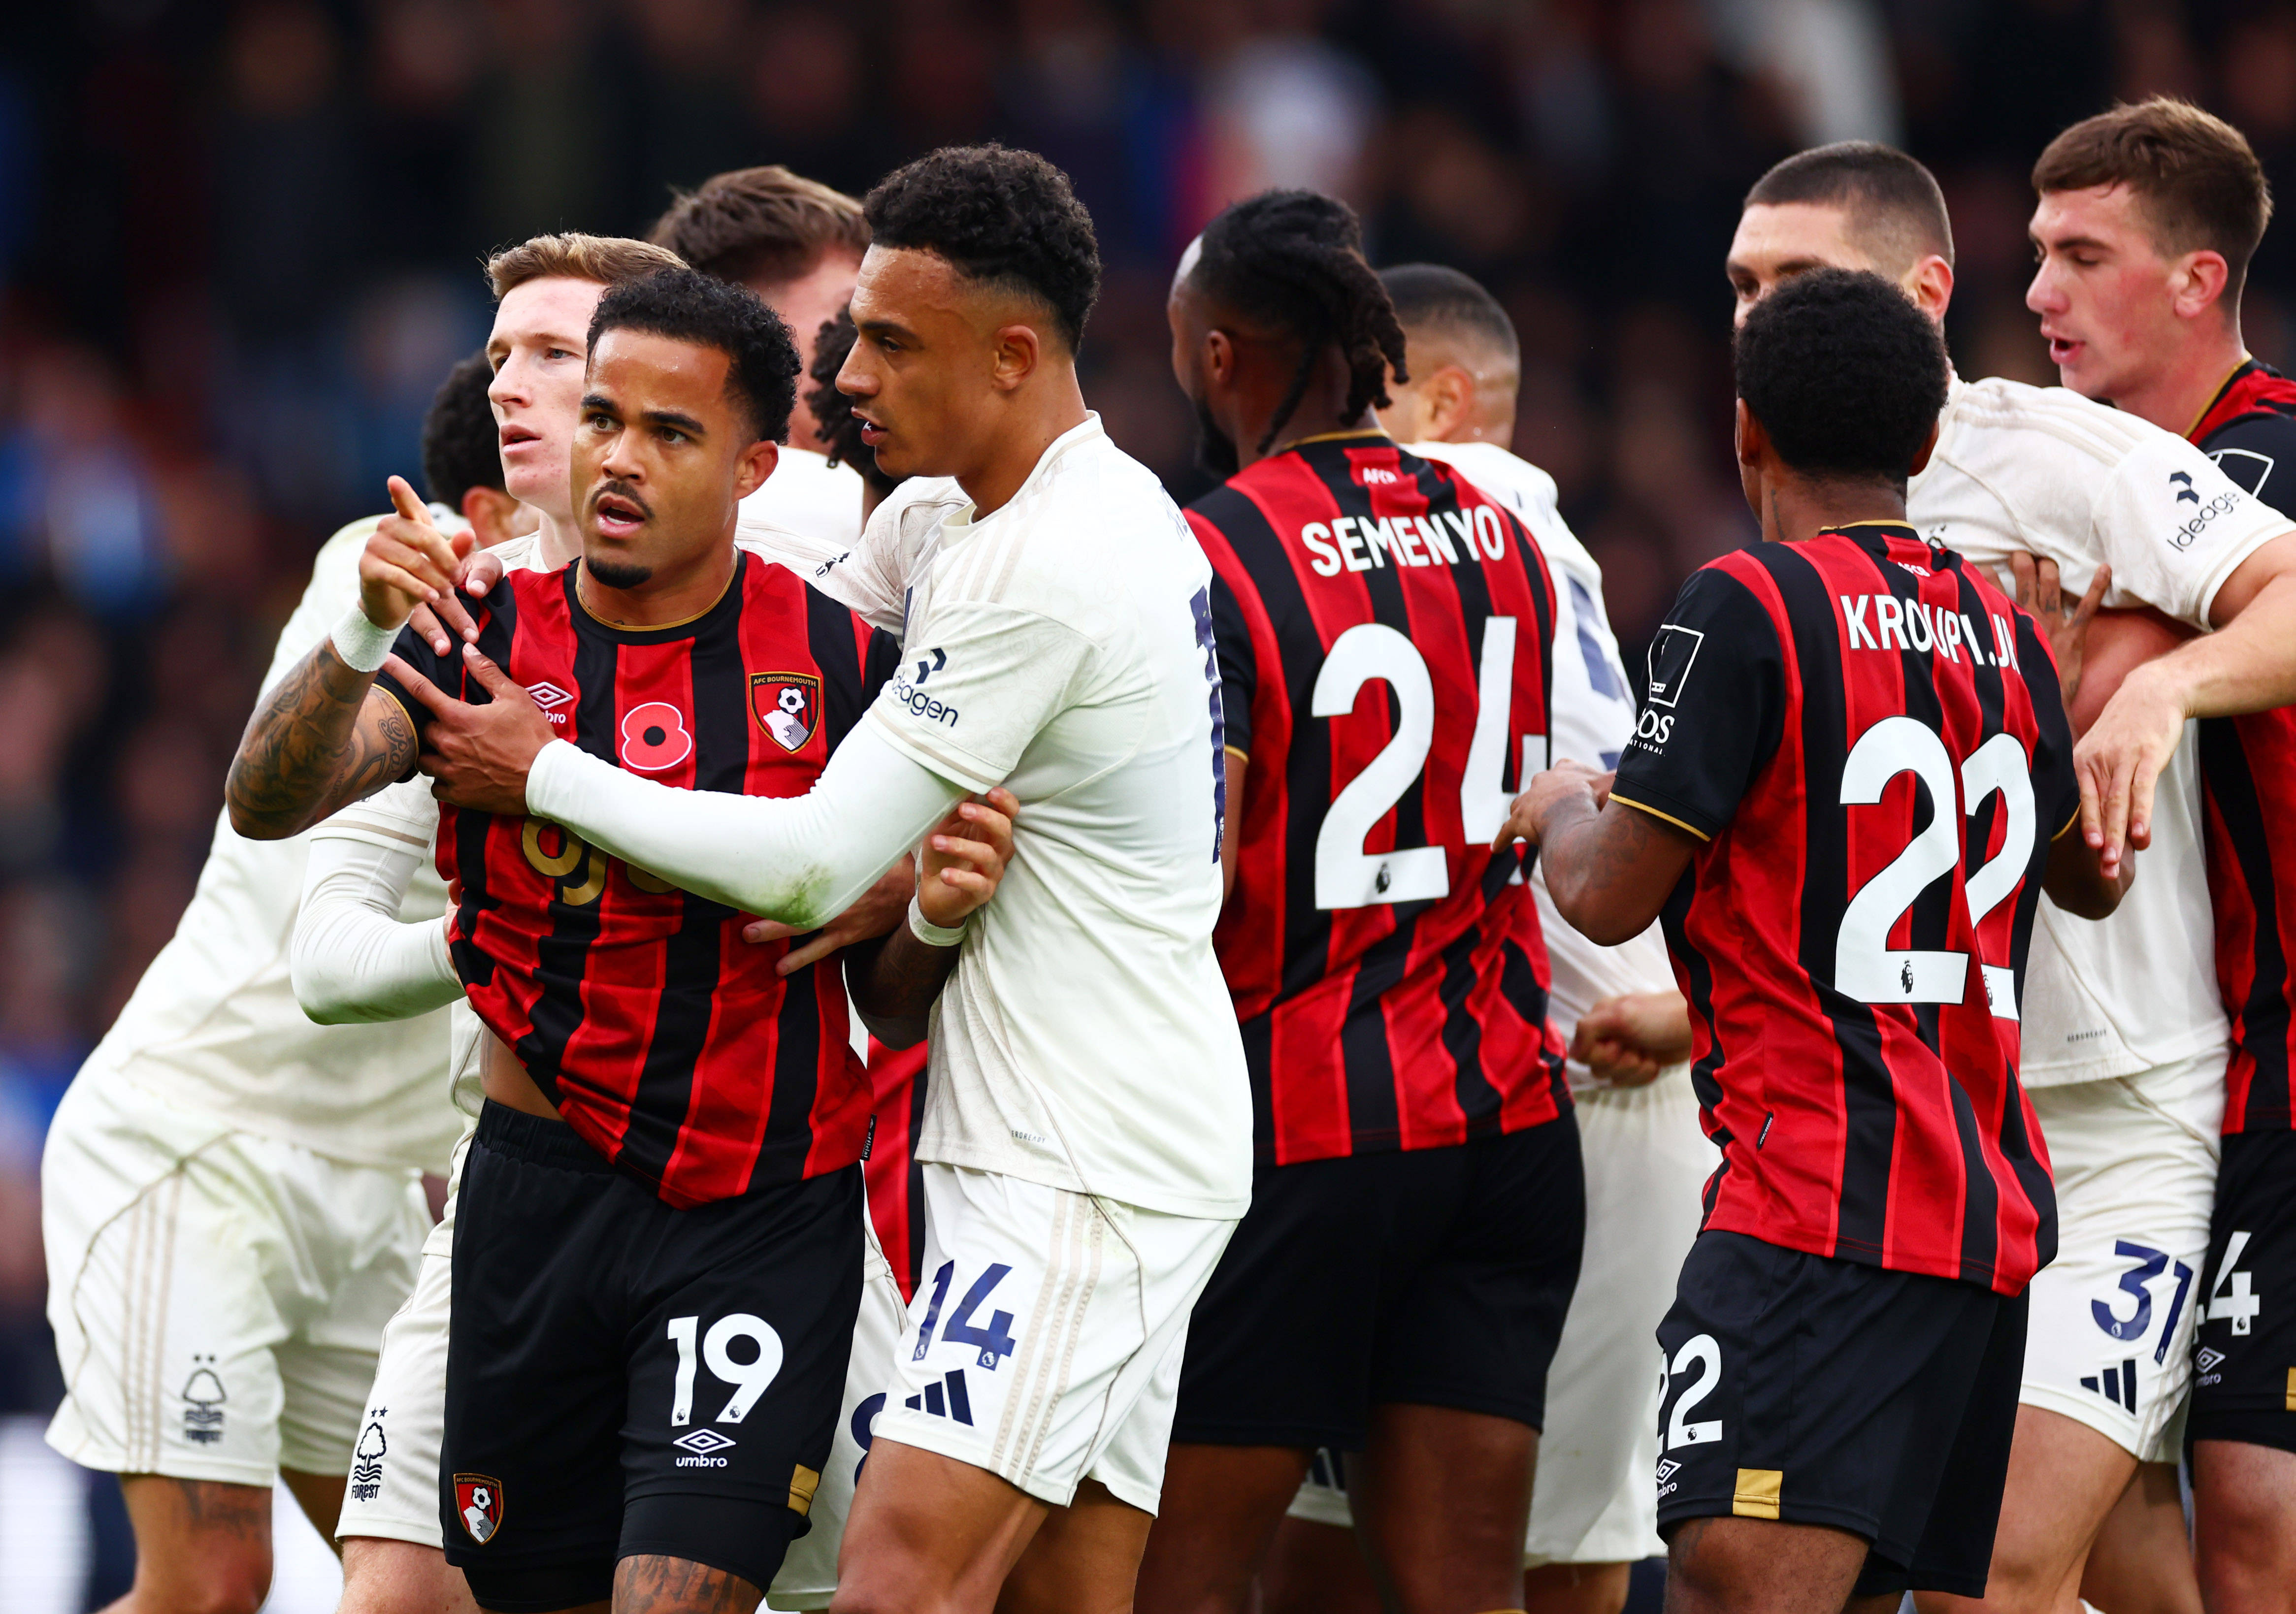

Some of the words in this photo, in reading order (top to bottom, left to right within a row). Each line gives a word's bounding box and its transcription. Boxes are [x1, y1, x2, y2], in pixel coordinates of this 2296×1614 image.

[1301, 505, 1505, 577] SEMENYO
[2167, 492, 2240, 552] Ideage
[767, 676, 817, 687] BOURNEMOUTH
[544, 710, 566, 724] bro
[1629, 738, 1664, 756] ATIONAL
[1637, 708, 1675, 744] OS
[1311, 615, 1547, 910] 24
[1835, 715, 2037, 1021] 22
[1011, 1130, 1046, 1143] EROREADY
[912, 1259, 1017, 1372] 14
[2091, 1239, 2193, 1366] 31
[2193, 1230, 2260, 1345] 4
[667, 1313, 784, 1427] 19
[676, 1454, 728, 1467] umbro
[1657, 1482, 1677, 1500] mbro
